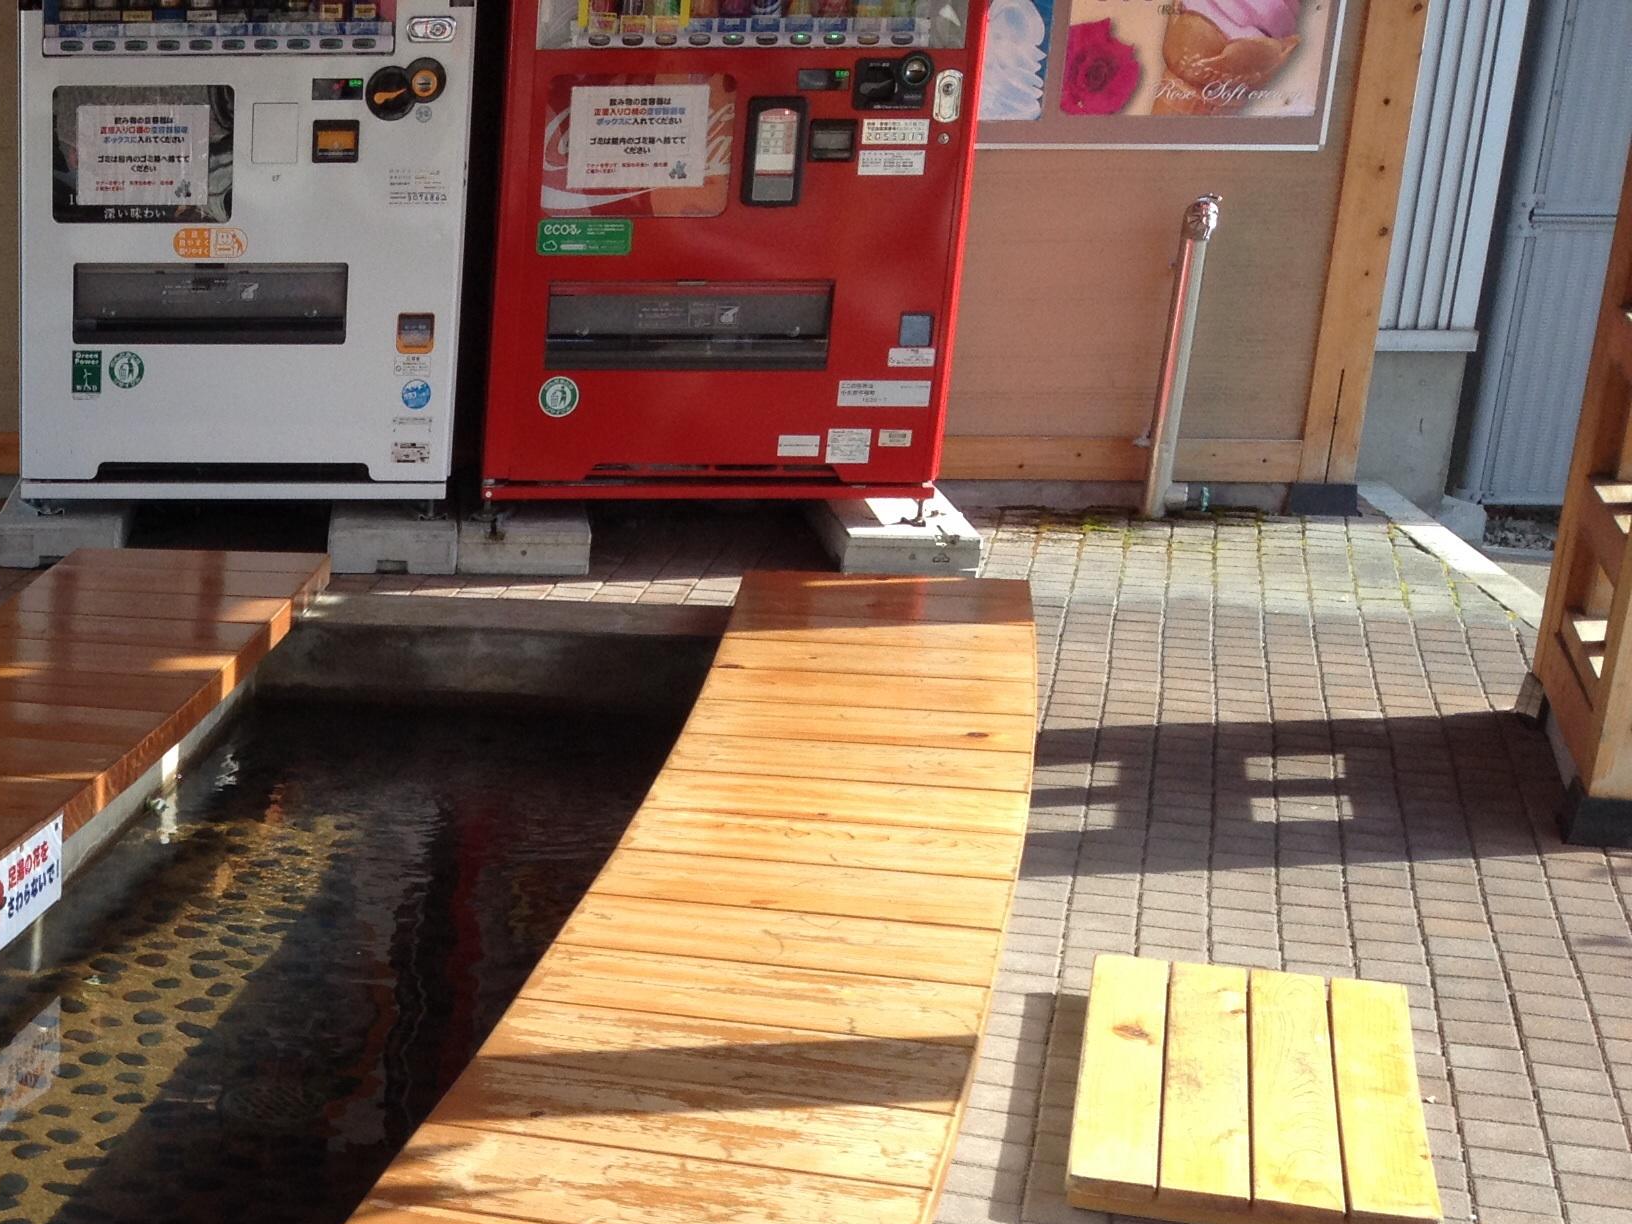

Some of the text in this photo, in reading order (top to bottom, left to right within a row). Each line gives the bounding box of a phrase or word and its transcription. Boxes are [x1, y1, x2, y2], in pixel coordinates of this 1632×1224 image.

[1153, 80, 1197, 100] Rose
[1202, 79, 1248, 105] Soft
[623, 146, 651, 155] ください
[104, 208, 166, 219] 深い味わい
[8, 840, 49, 890] 足湯の花を
